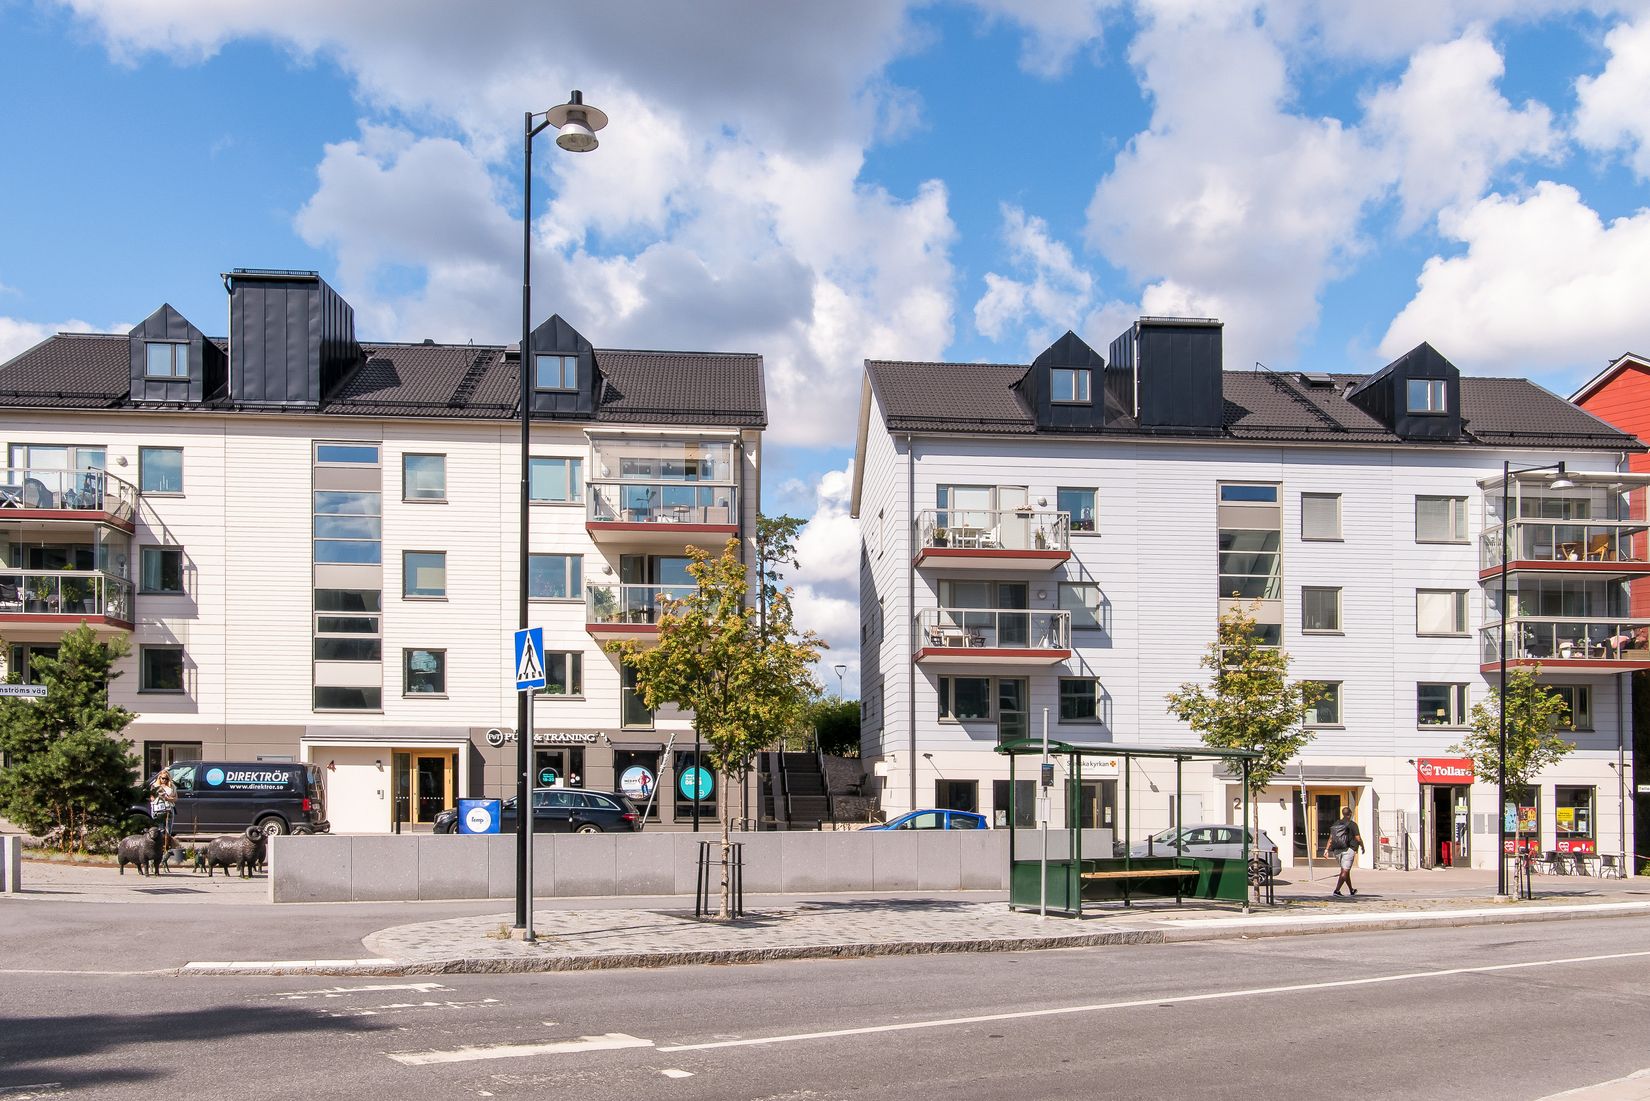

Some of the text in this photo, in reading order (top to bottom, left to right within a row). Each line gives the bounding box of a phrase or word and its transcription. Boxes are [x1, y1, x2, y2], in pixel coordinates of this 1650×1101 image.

[32, 687, 46, 695] väg
[534, 733, 542, 741] &
[544, 732, 596, 741] TRÄNING
[226, 769, 289, 782] DIREKTRÖR
[1234, 798, 1241, 810] 2
